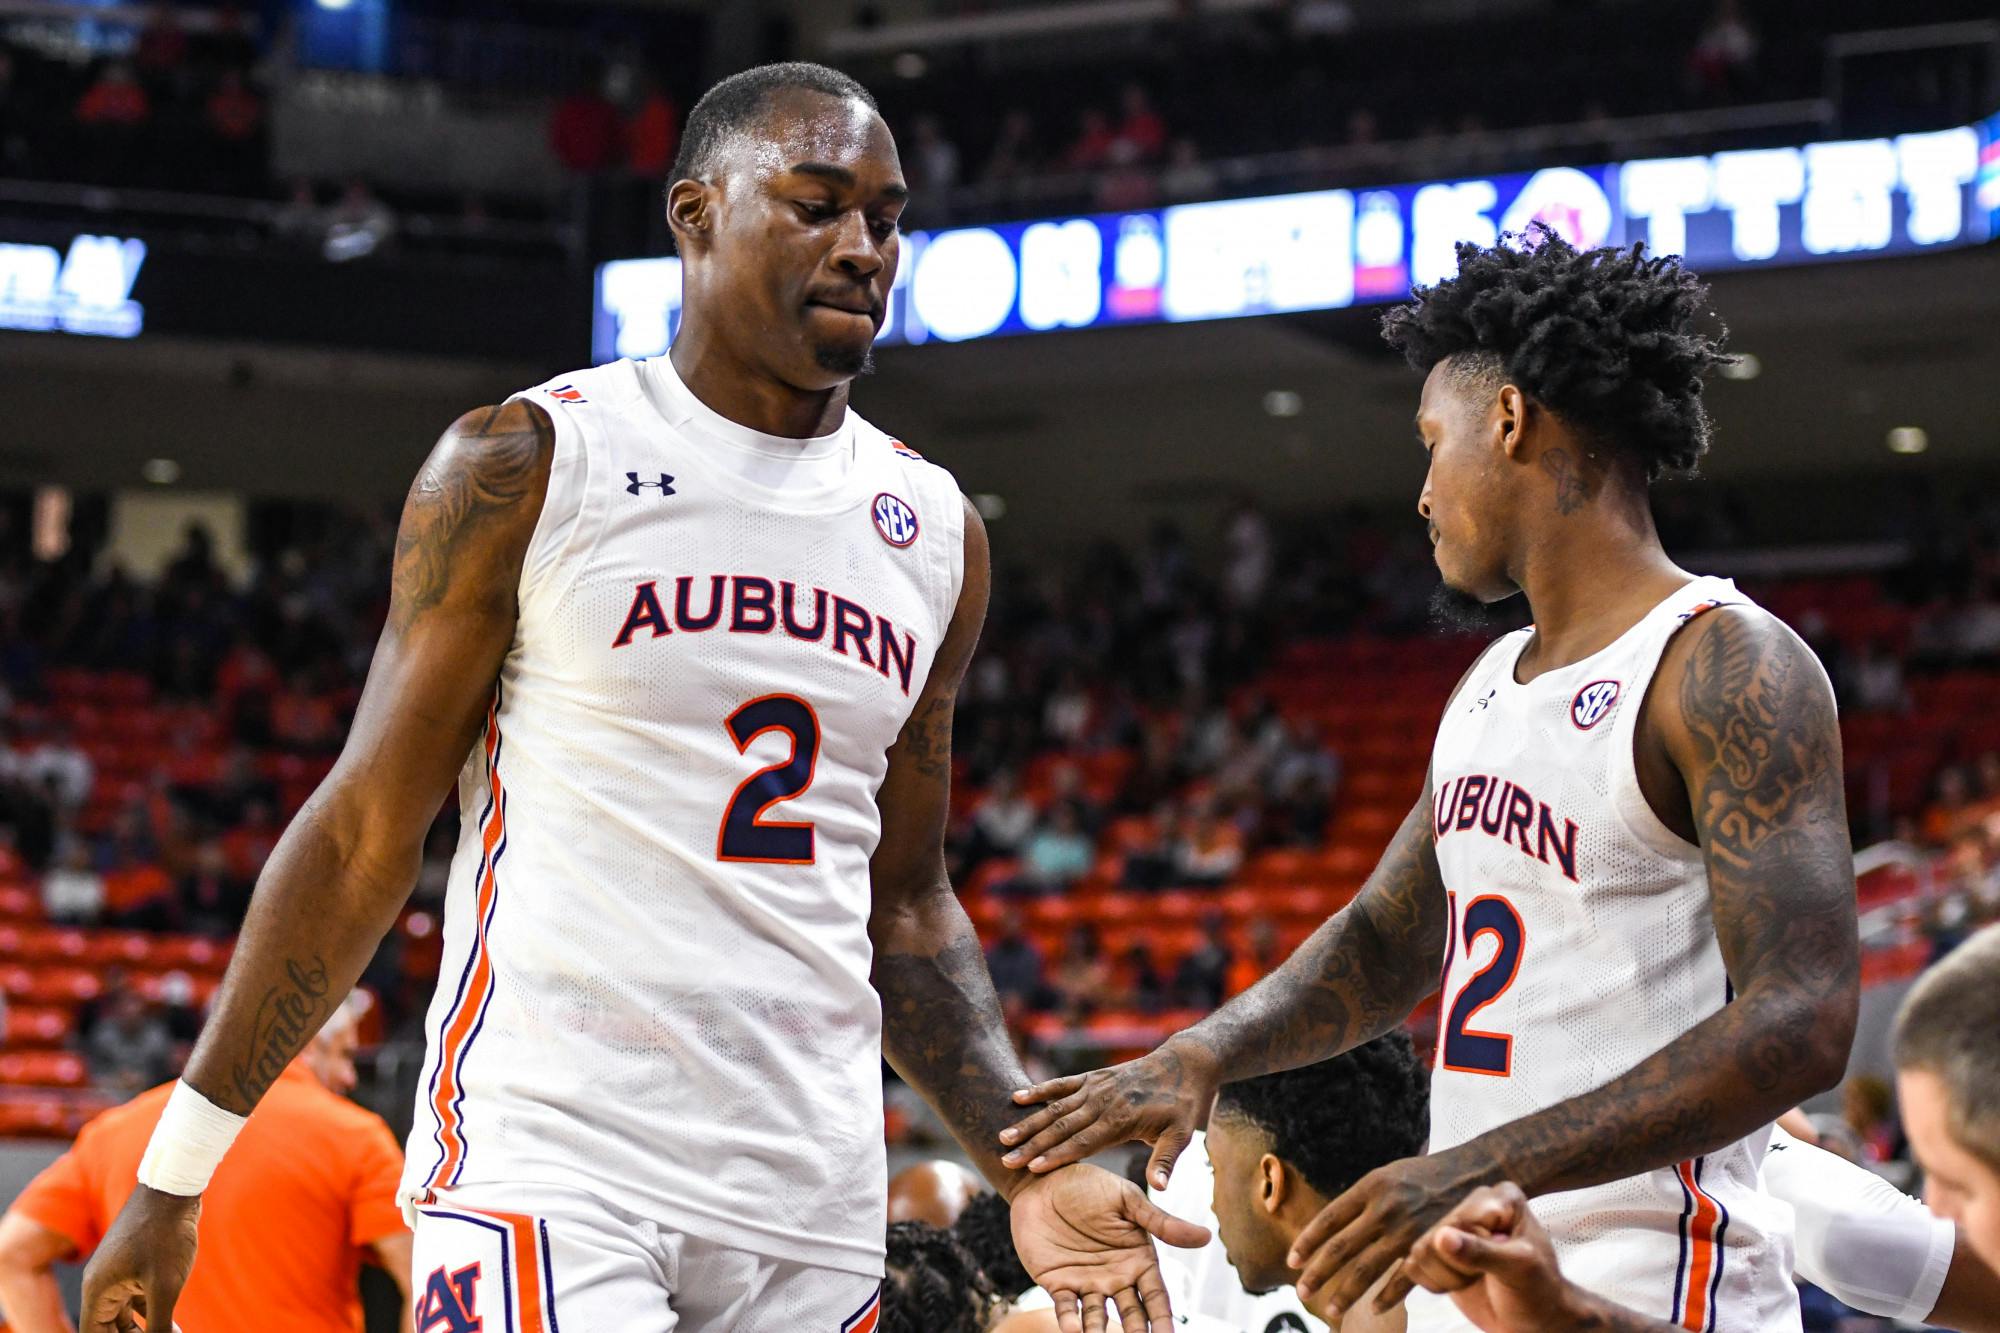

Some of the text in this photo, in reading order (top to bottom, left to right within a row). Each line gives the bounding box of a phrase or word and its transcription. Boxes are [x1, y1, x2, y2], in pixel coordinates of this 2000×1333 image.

[875, 494, 916, 543] SEC
[612, 575, 916, 697] AUBURN
[1574, 681, 1619, 727] SEC
[717, 693, 821, 865] 2
[1433, 774, 1580, 884] UBURN
